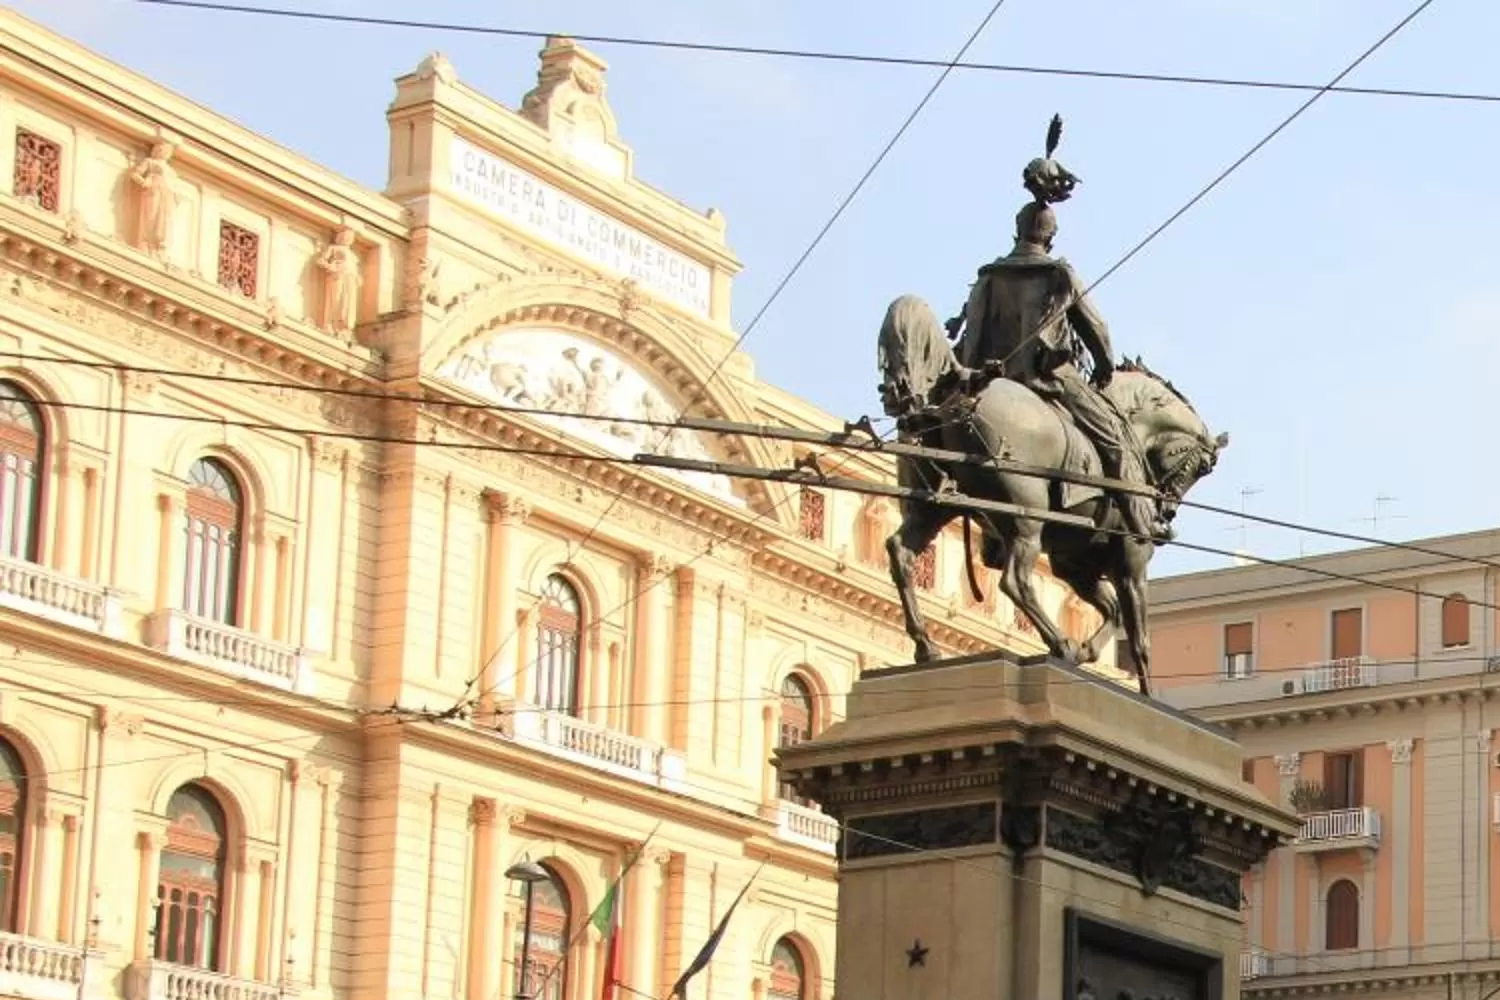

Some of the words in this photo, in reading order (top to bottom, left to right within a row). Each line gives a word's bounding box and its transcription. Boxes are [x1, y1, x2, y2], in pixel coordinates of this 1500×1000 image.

[463, 150, 545, 209] CAMERA
[557, 199, 576, 226] DI
[587, 215, 698, 289] COMMERCIO
